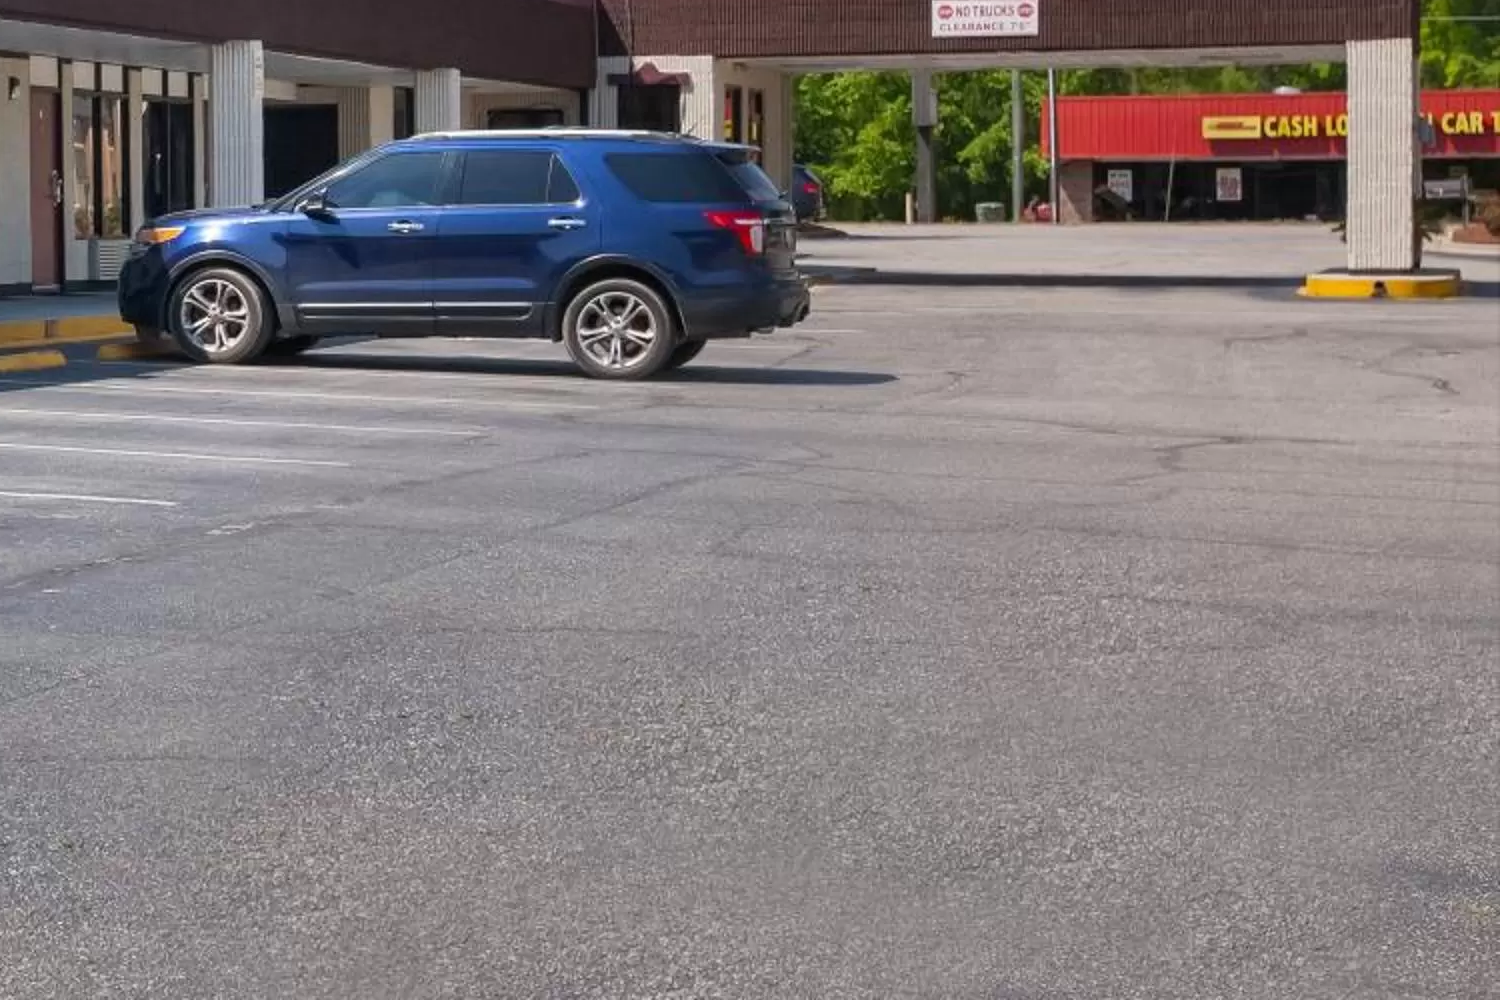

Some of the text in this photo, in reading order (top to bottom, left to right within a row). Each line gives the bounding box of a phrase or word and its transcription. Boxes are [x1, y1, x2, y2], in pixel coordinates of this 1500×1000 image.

[955, 6, 970, 18] NO
[973, 5, 1015, 18] TRUCKS
[939, 21, 1004, 32] CLEARANCE
[1263, 115, 1318, 138] CASH
[1325, 113, 1348, 137] LO
[1441, 111, 1485, 134] CAR
